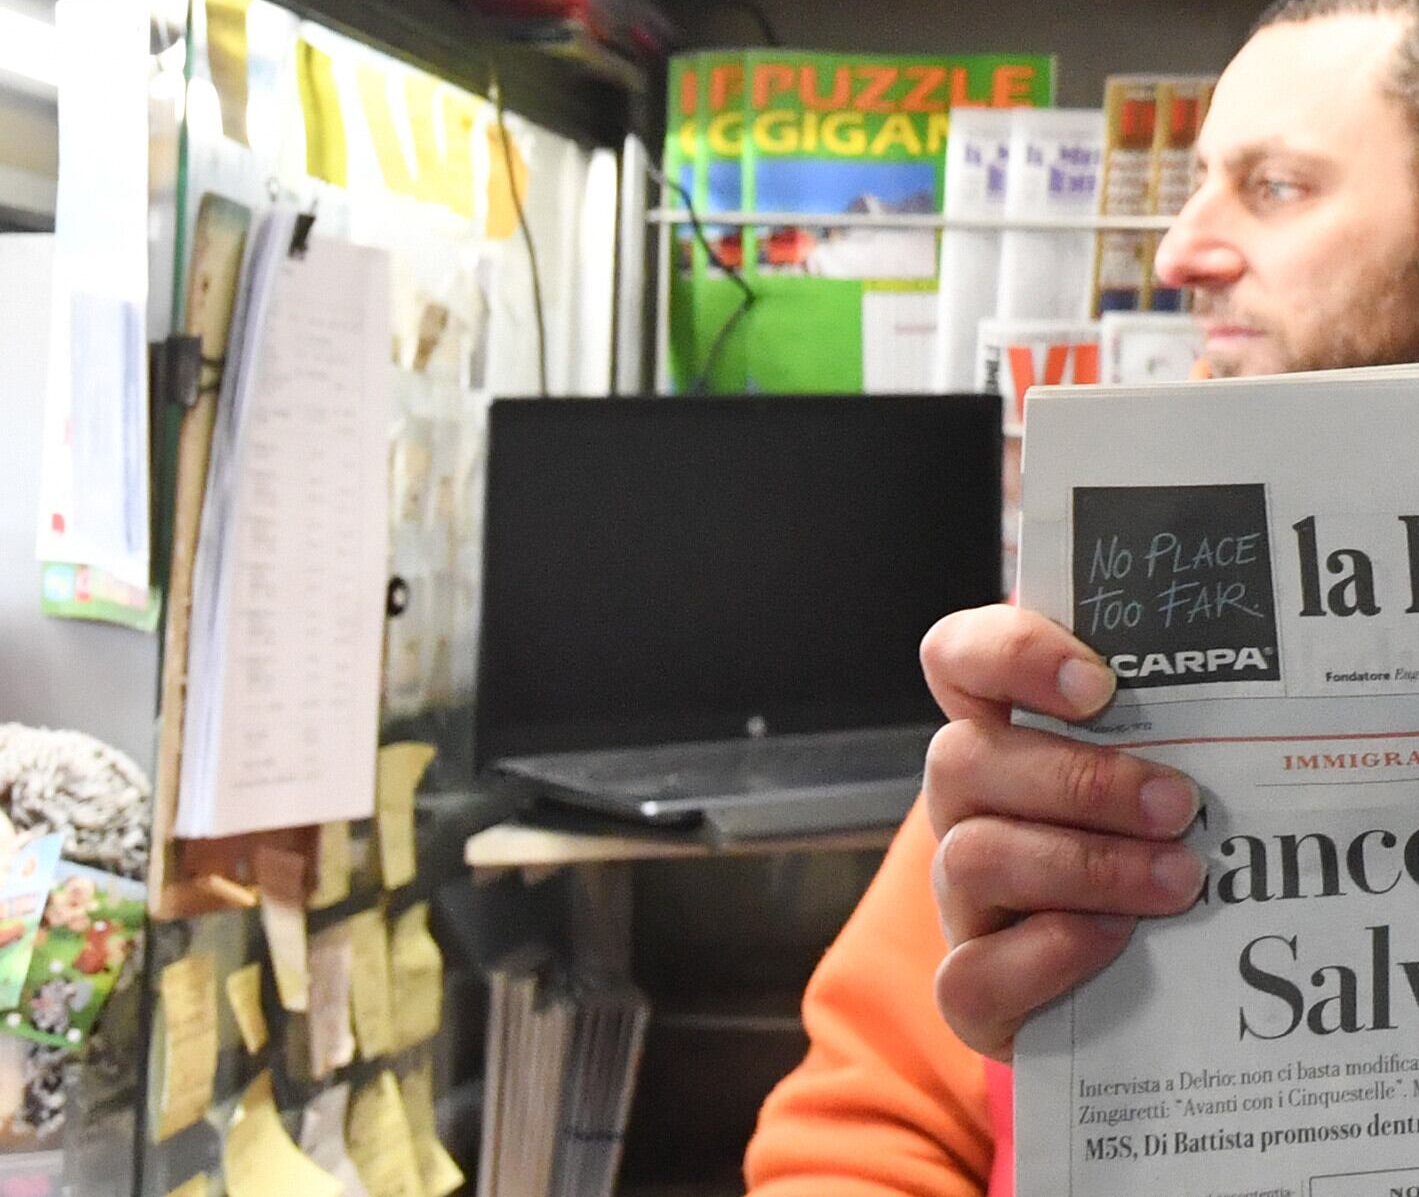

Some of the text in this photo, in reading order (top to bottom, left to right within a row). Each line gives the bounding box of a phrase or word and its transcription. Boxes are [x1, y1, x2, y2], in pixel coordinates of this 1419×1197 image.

[752, 62, 1036, 113] PUZZLE
[1291, 516, 1382, 618] la
[1104, 647, 1269, 679] CARPA
[1325, 668, 1391, 684] Fondatore
[1079, 1076, 1161, 1098] Intervista
[1165, 1080, 1174, 1093] a
[1179, 1071, 1237, 1091] Delrio:
[1240, 1069, 1273, 1086] non
[1277, 1066, 1292, 1083] ci
[1297, 1061, 1341, 1081] basta
[1078, 1103, 1170, 1127] Zingaretti:
[1242, 1094, 1273, 1113] con
[1085, 1135, 1138, 1162] M5S,
[1144, 1132, 1167, 1155] Di
[1174, 1128, 1255, 1154] Battista
[1260, 1120, 1362, 1152] promosso
